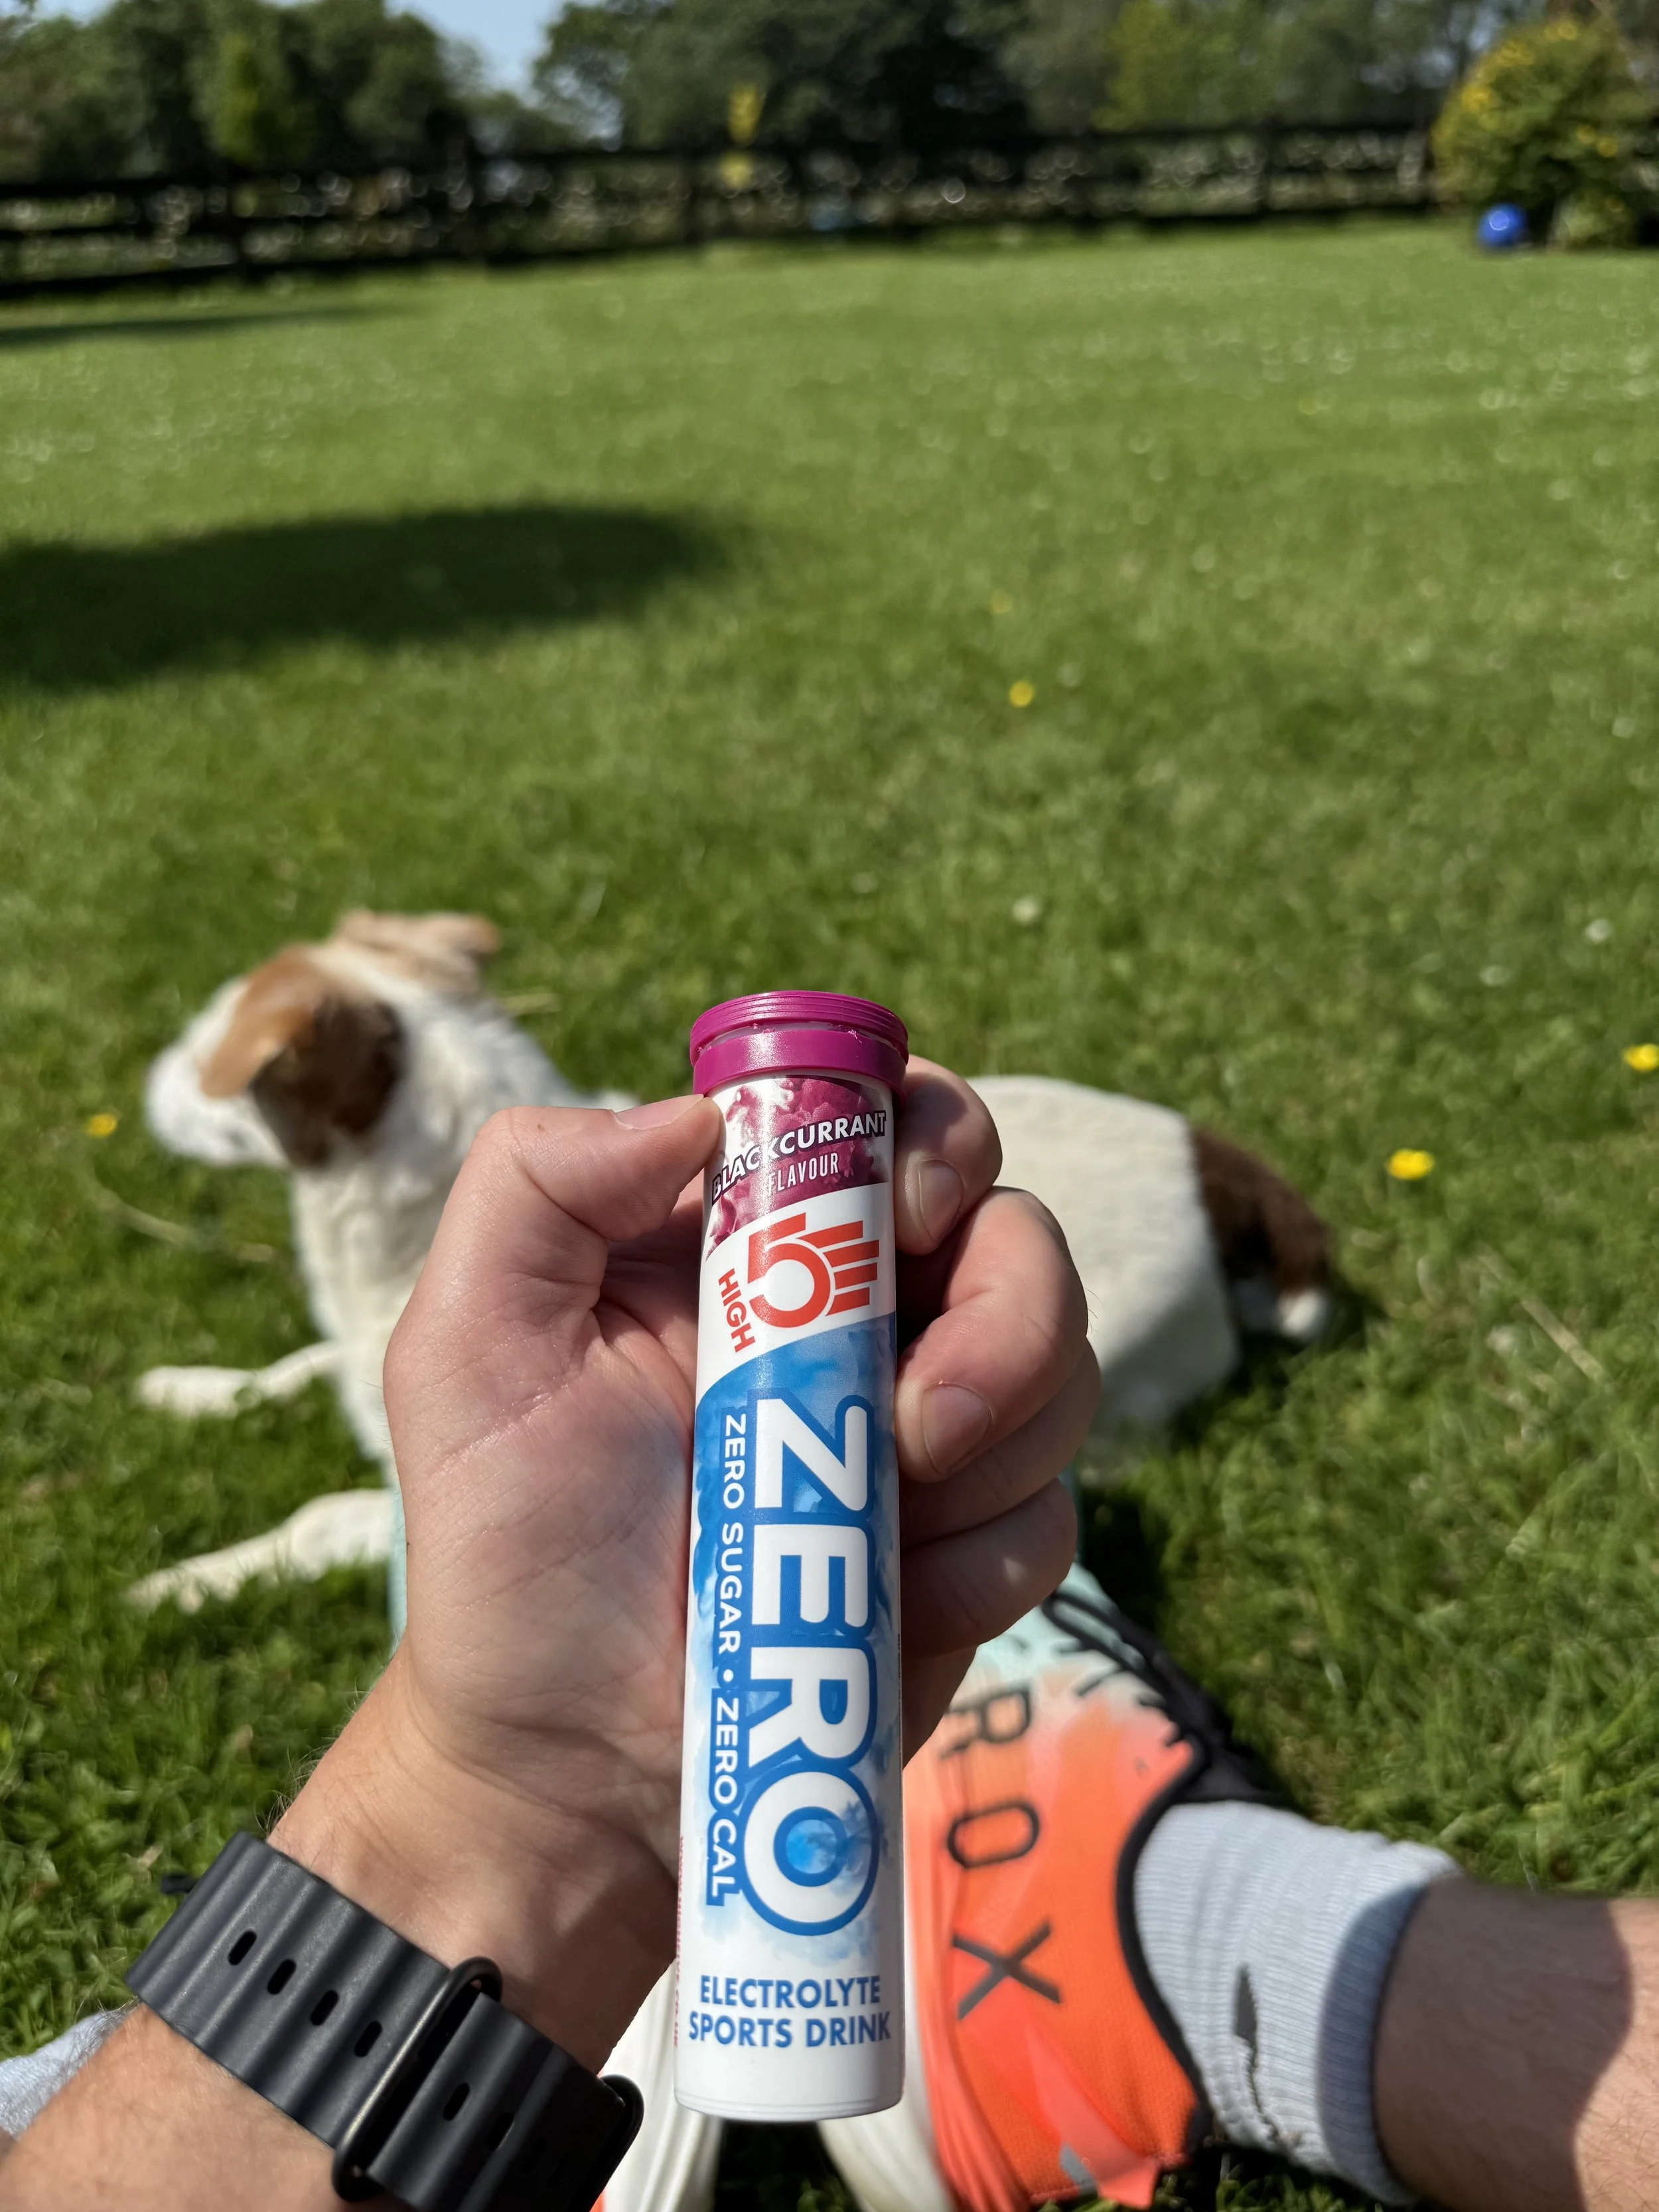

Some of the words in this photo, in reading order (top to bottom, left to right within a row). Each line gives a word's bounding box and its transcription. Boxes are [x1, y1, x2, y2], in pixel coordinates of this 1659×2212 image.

[712, 1110, 887, 1205] BLACKCURRANT
[767, 1152, 839, 1195] FLAVOUR
[718, 1268, 756, 1353] HIGH
[747, 1212, 831, 1328] 5
[723, 1413, 746, 1510] ZERO
[719, 1522, 744, 1655] SUGAR
[744, 1397, 868, 1923] ZERO
[713, 1697, 739, 1805] ZERO
[711, 1818, 737, 1897] CAL
[940, 1636, 1061, 2022] ROX
[688, 2010, 792, 2049] SPORTS
[806, 2011, 891, 2047] DRINK
[700, 1974, 881, 2009] ELECTROLYTE
